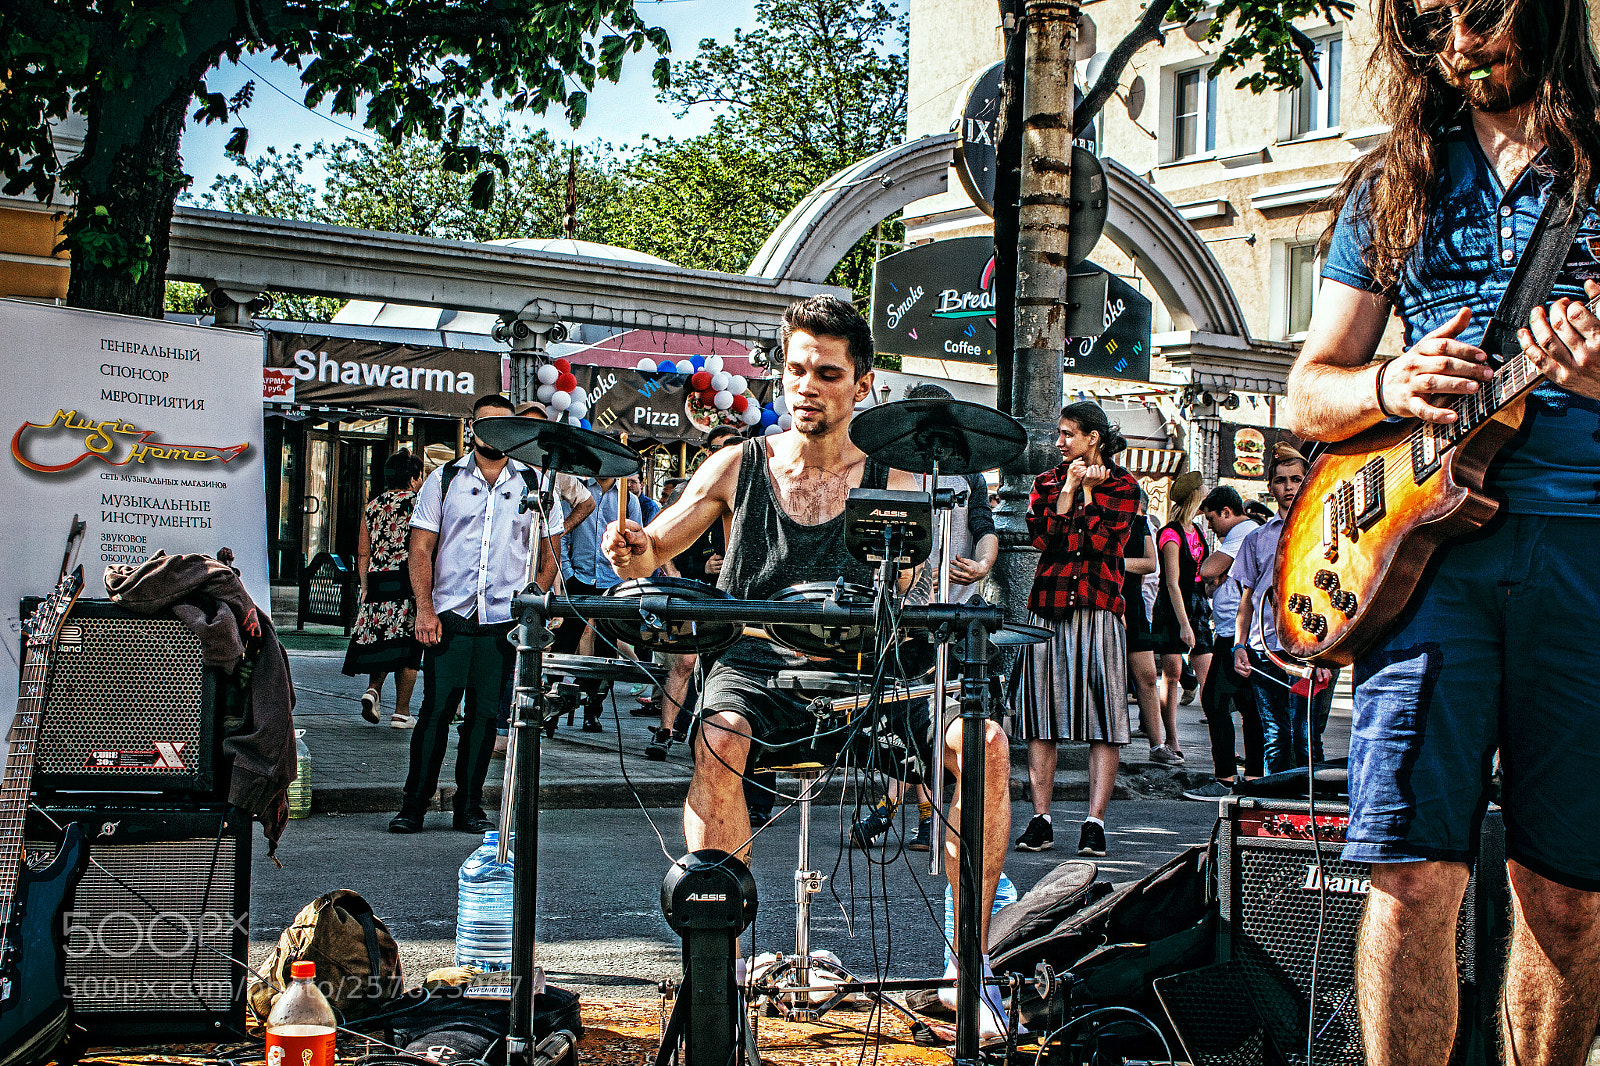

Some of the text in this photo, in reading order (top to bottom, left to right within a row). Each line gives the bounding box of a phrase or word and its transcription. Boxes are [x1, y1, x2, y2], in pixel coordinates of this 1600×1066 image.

[886, 285, 925, 330] Smoke
[100, 338, 201, 362] ГЕНЕРАЛЬНЫЙ
[944, 340, 981, 356] Coffee
[99, 363, 170, 383] СПОНСОР
[294, 349, 475, 396] Shawarma
[268, 385, 284, 393] руб.
[100, 388, 205, 411] МЕРОПРИЯТИЯ
[633, 406, 680, 427] Pizza
[50, 408, 136, 454] Music
[126, 444, 209, 464] Home
[100, 472, 227, 489] СЕТЬ МУЗЫКАЛЬНЫХ МАГАЗИНОВ
[101, 493, 211, 512] МУЗЫКАЛЬНЫЕ
[101, 510, 212, 529] ИНСТРУМЕНТЫ
[869, 508, 908, 518] ALESIS
[100, 532, 147, 544] ЗВУКОВОЕ
[100, 543, 147, 554] СВЕТОВОЕ
[686, 892, 727, 902] ALESIS
